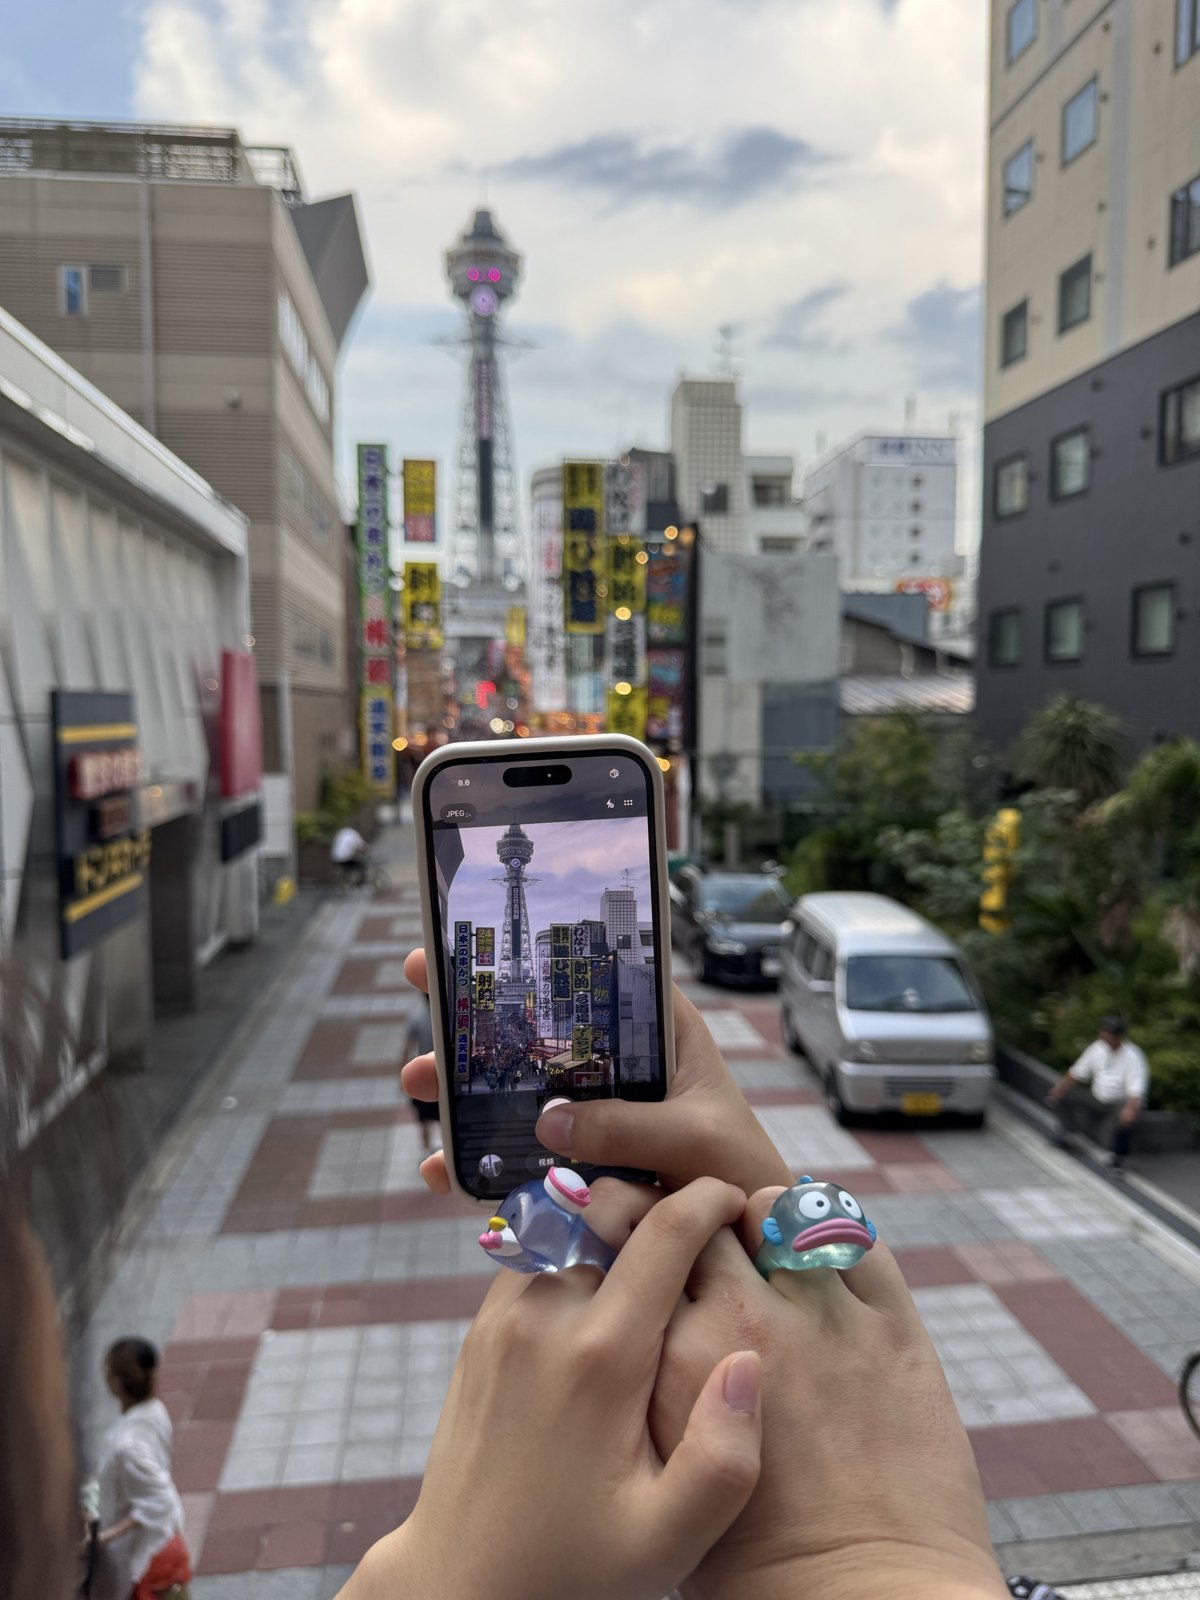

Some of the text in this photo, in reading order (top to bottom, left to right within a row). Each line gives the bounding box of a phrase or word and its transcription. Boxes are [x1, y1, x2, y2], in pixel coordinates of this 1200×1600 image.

[445, 809, 465, 818] JPEG
[458, 924, 469, 987] 日本一の串かつ
[573, 926, 584, 956] わなげ
[553, 944, 570, 998] 遊び放題
[574, 960, 589, 989] 射的
[478, 973, 493, 1001] 射的
[575, 994, 590, 1023] 弓道場
[538, 1158, 554, 1166] 视频
